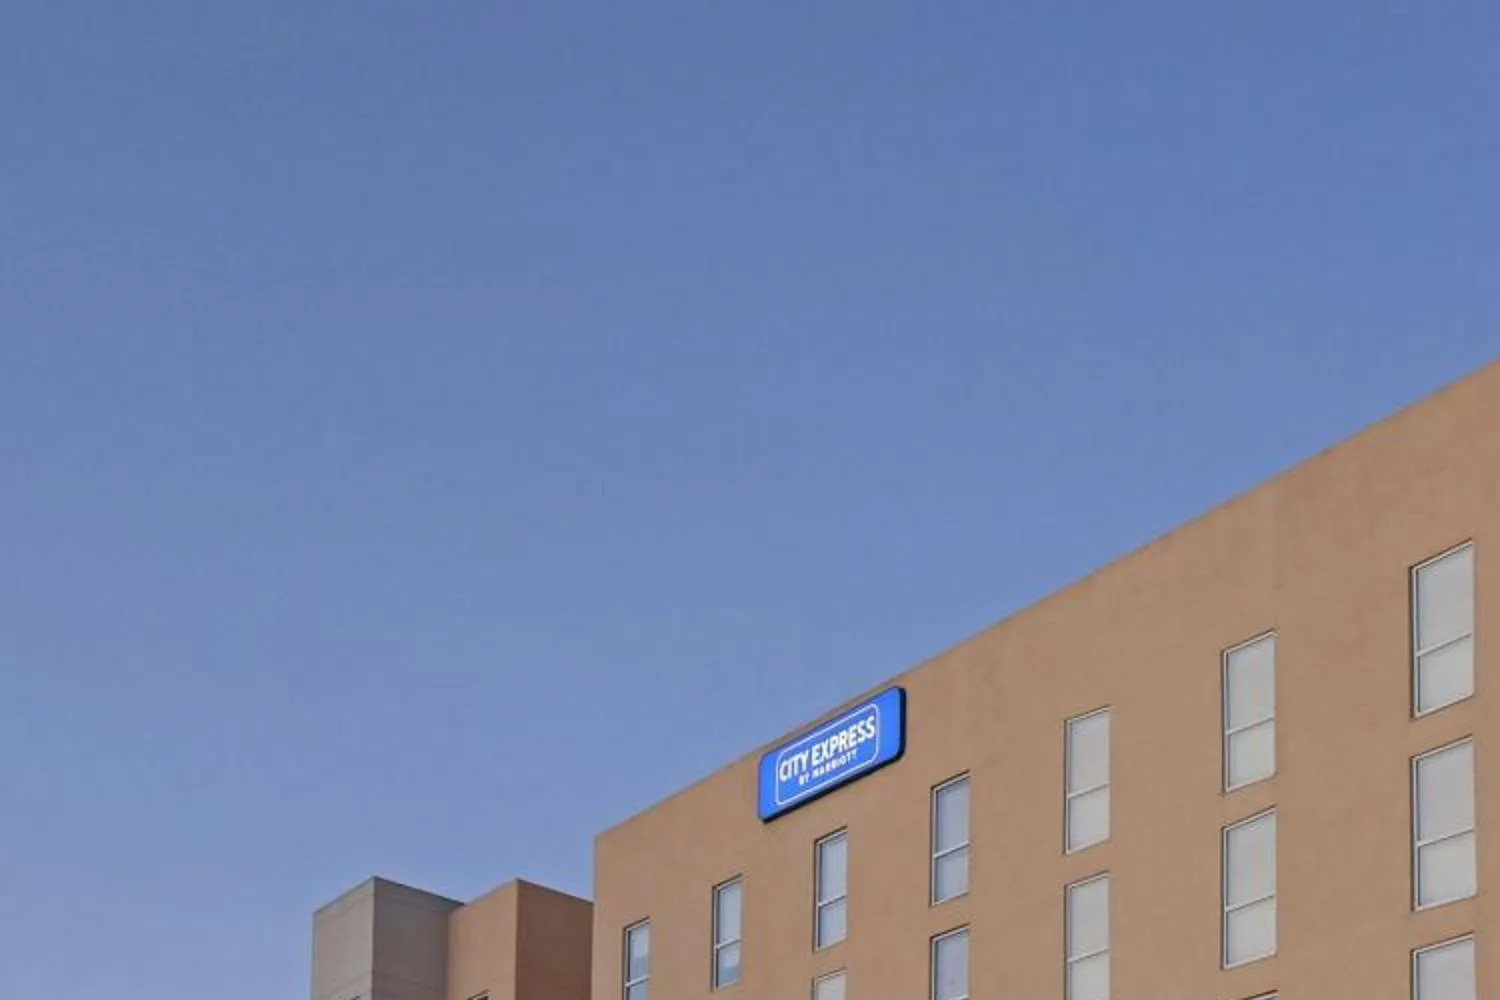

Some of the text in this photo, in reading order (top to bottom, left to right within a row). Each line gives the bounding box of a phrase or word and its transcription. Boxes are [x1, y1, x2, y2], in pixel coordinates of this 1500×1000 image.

[779, 715, 875, 782] CITY EXPRESS
[798, 773, 810, 785] BY
